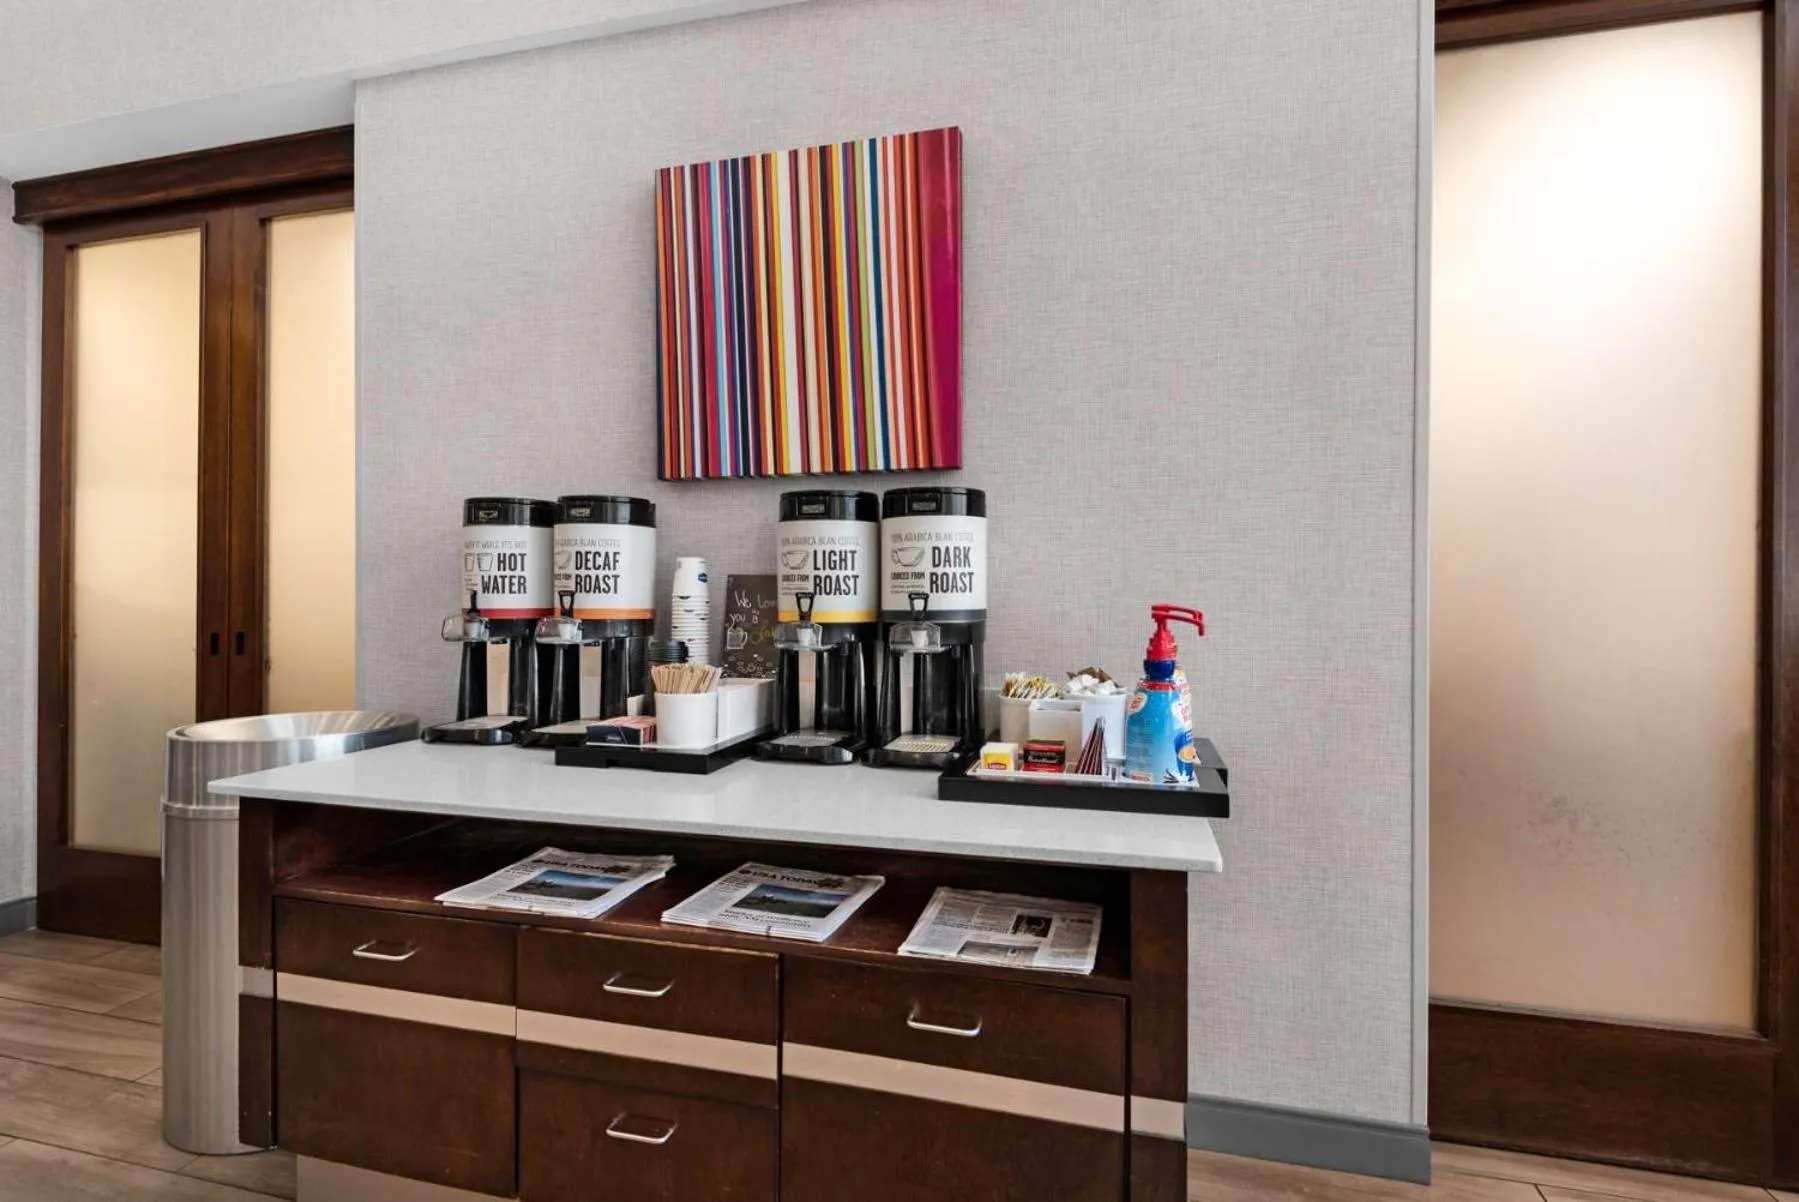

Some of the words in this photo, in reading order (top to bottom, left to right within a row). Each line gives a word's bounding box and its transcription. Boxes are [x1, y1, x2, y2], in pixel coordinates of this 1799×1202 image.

[497, 552, 527, 572] HOT
[575, 550, 621, 571] DECAF
[813, 549, 858, 571] LIGHT
[931, 546, 972, 568] DARK
[481, 574, 527, 594] WATER
[574, 574, 621, 594] ROAST
[813, 574, 860, 596] ROAST
[911, 571, 926, 580] FROM
[929, 571, 975, 594] ROAST
[734, 590, 752, 610] We
[752, 870, 777, 880] USA
[780, 874, 818, 885] TODAY
